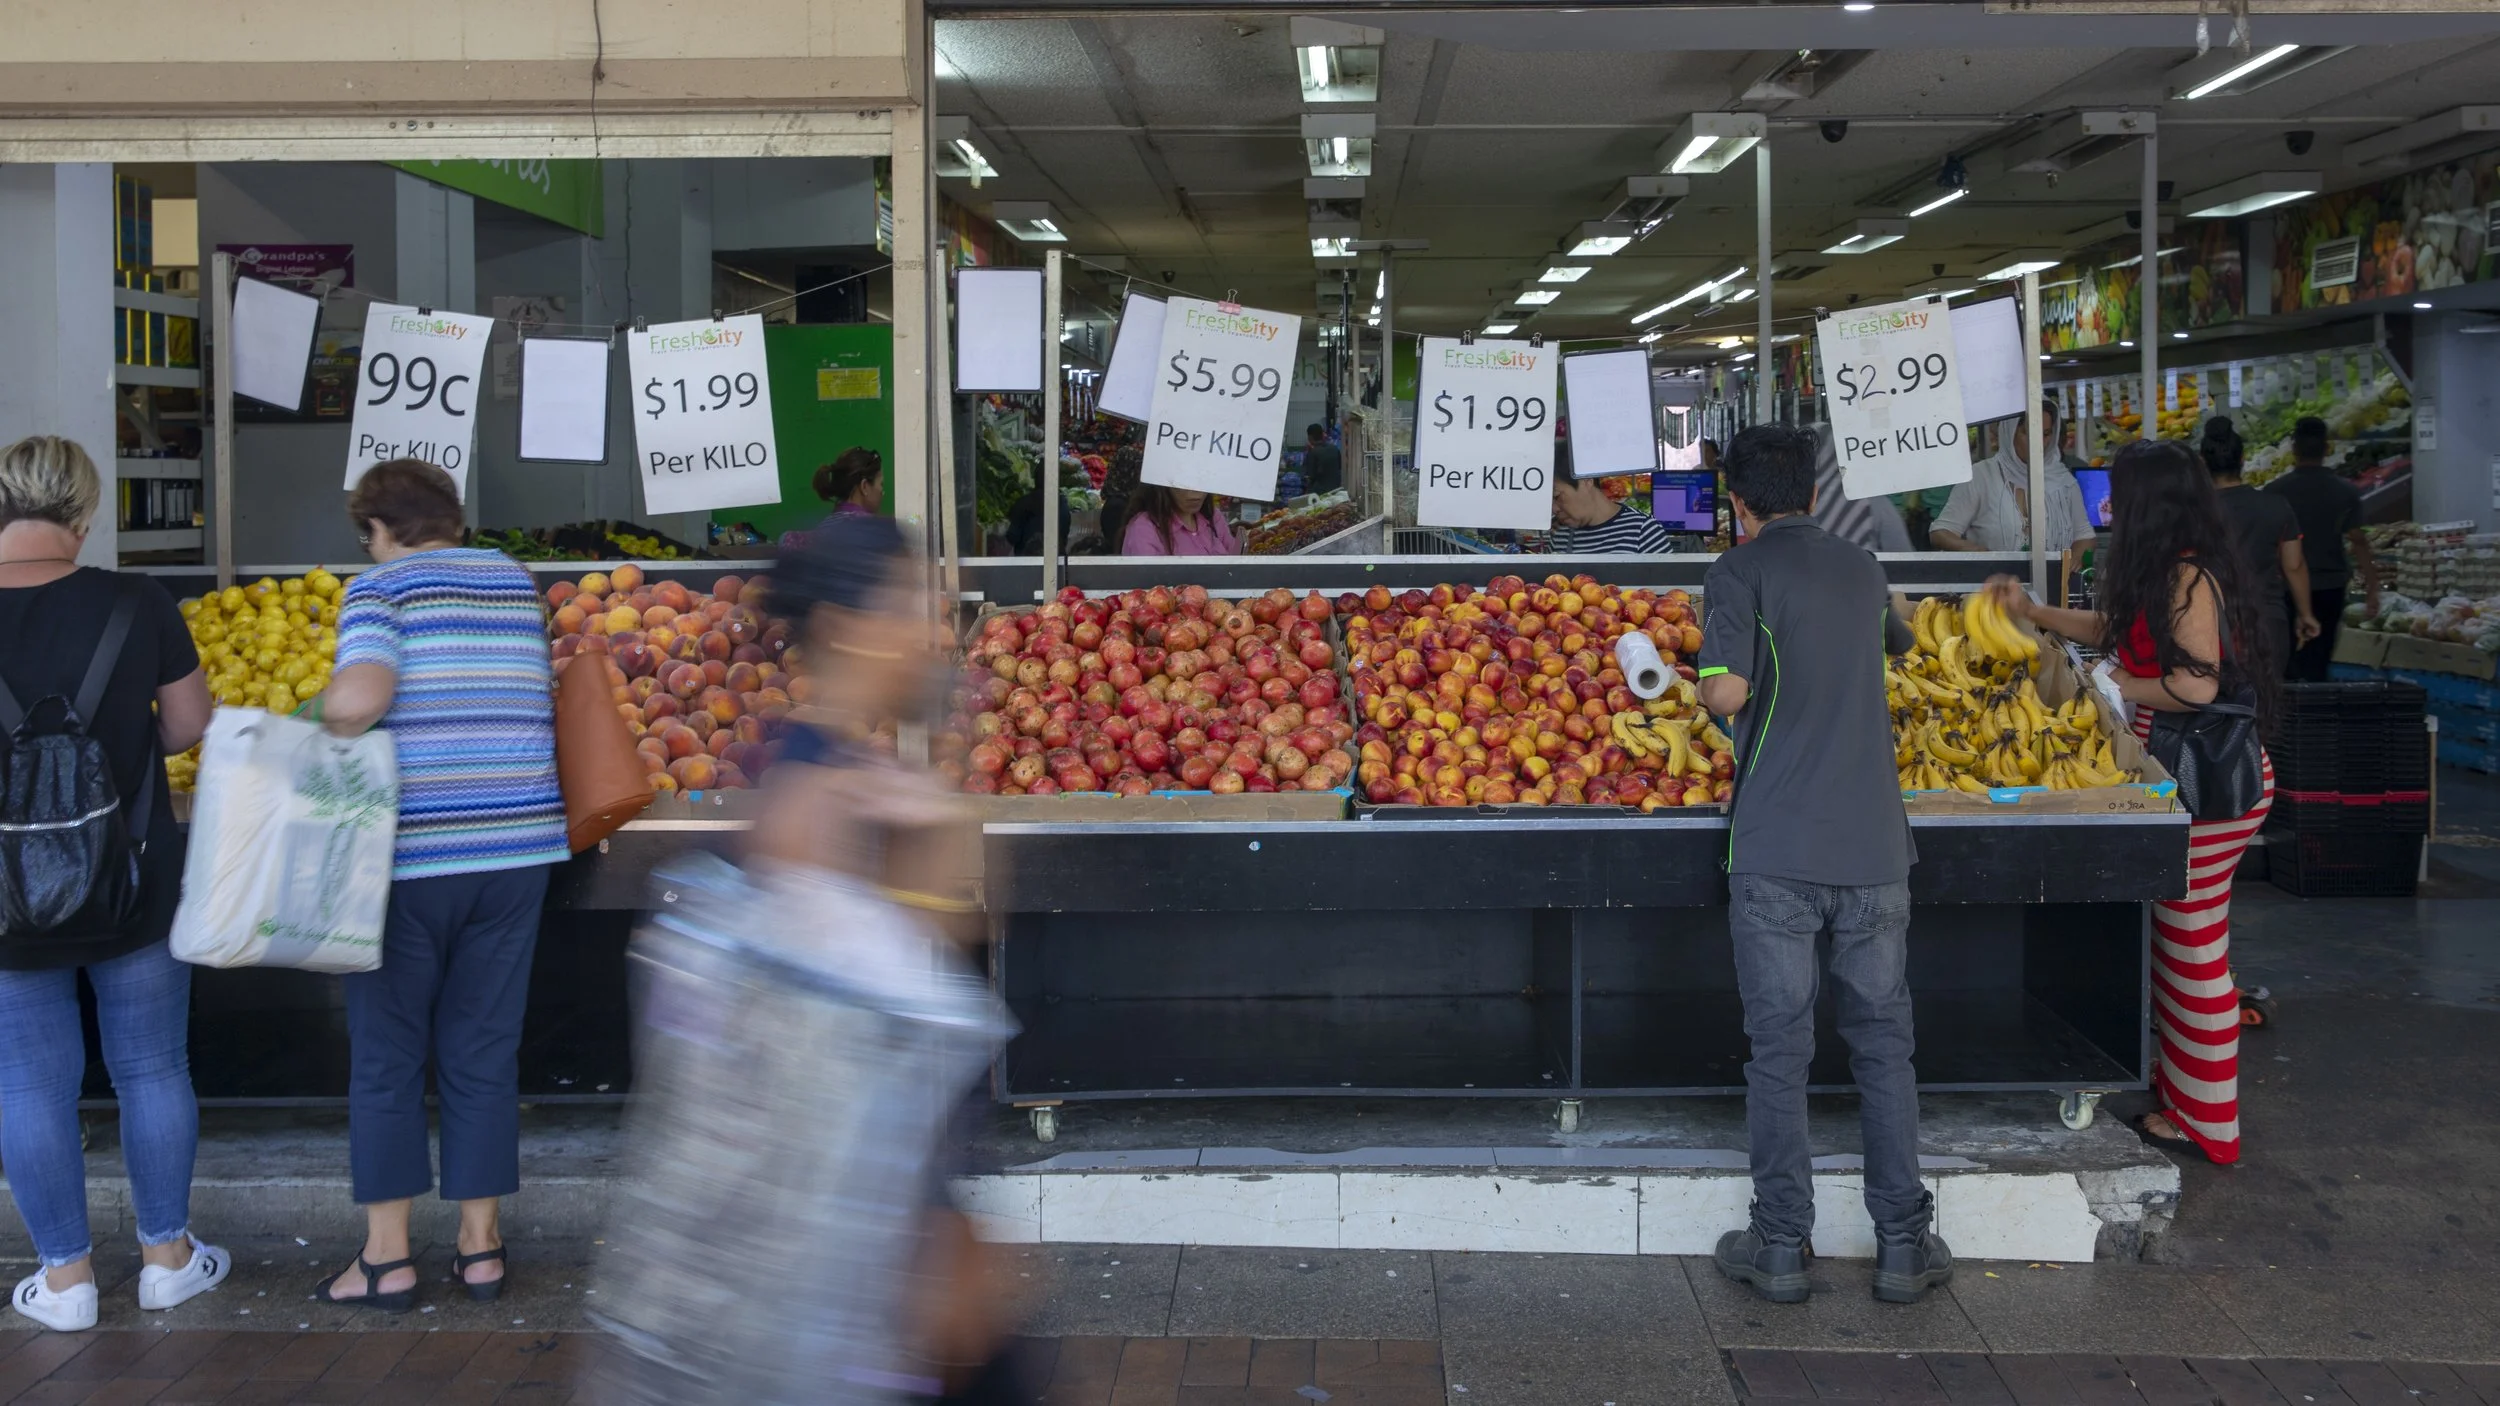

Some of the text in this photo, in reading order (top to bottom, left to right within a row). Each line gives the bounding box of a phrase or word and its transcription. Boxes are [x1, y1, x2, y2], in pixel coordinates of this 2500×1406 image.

[367, 352, 470, 417] 99c
[645, 372, 759, 420] $1.99
[1167, 350, 1281, 402] $5.99
[1836, 353, 1948, 406] $2.99
[1433, 390, 1546, 433] $1.99
[359, 434, 462, 469] Per KILO
[650, 442, 767, 476] Per KILO
[1156, 423, 1272, 462] Per KILO
[1844, 422, 1958, 461] Per KILO
[1430, 464, 1544, 491] Per KILO
